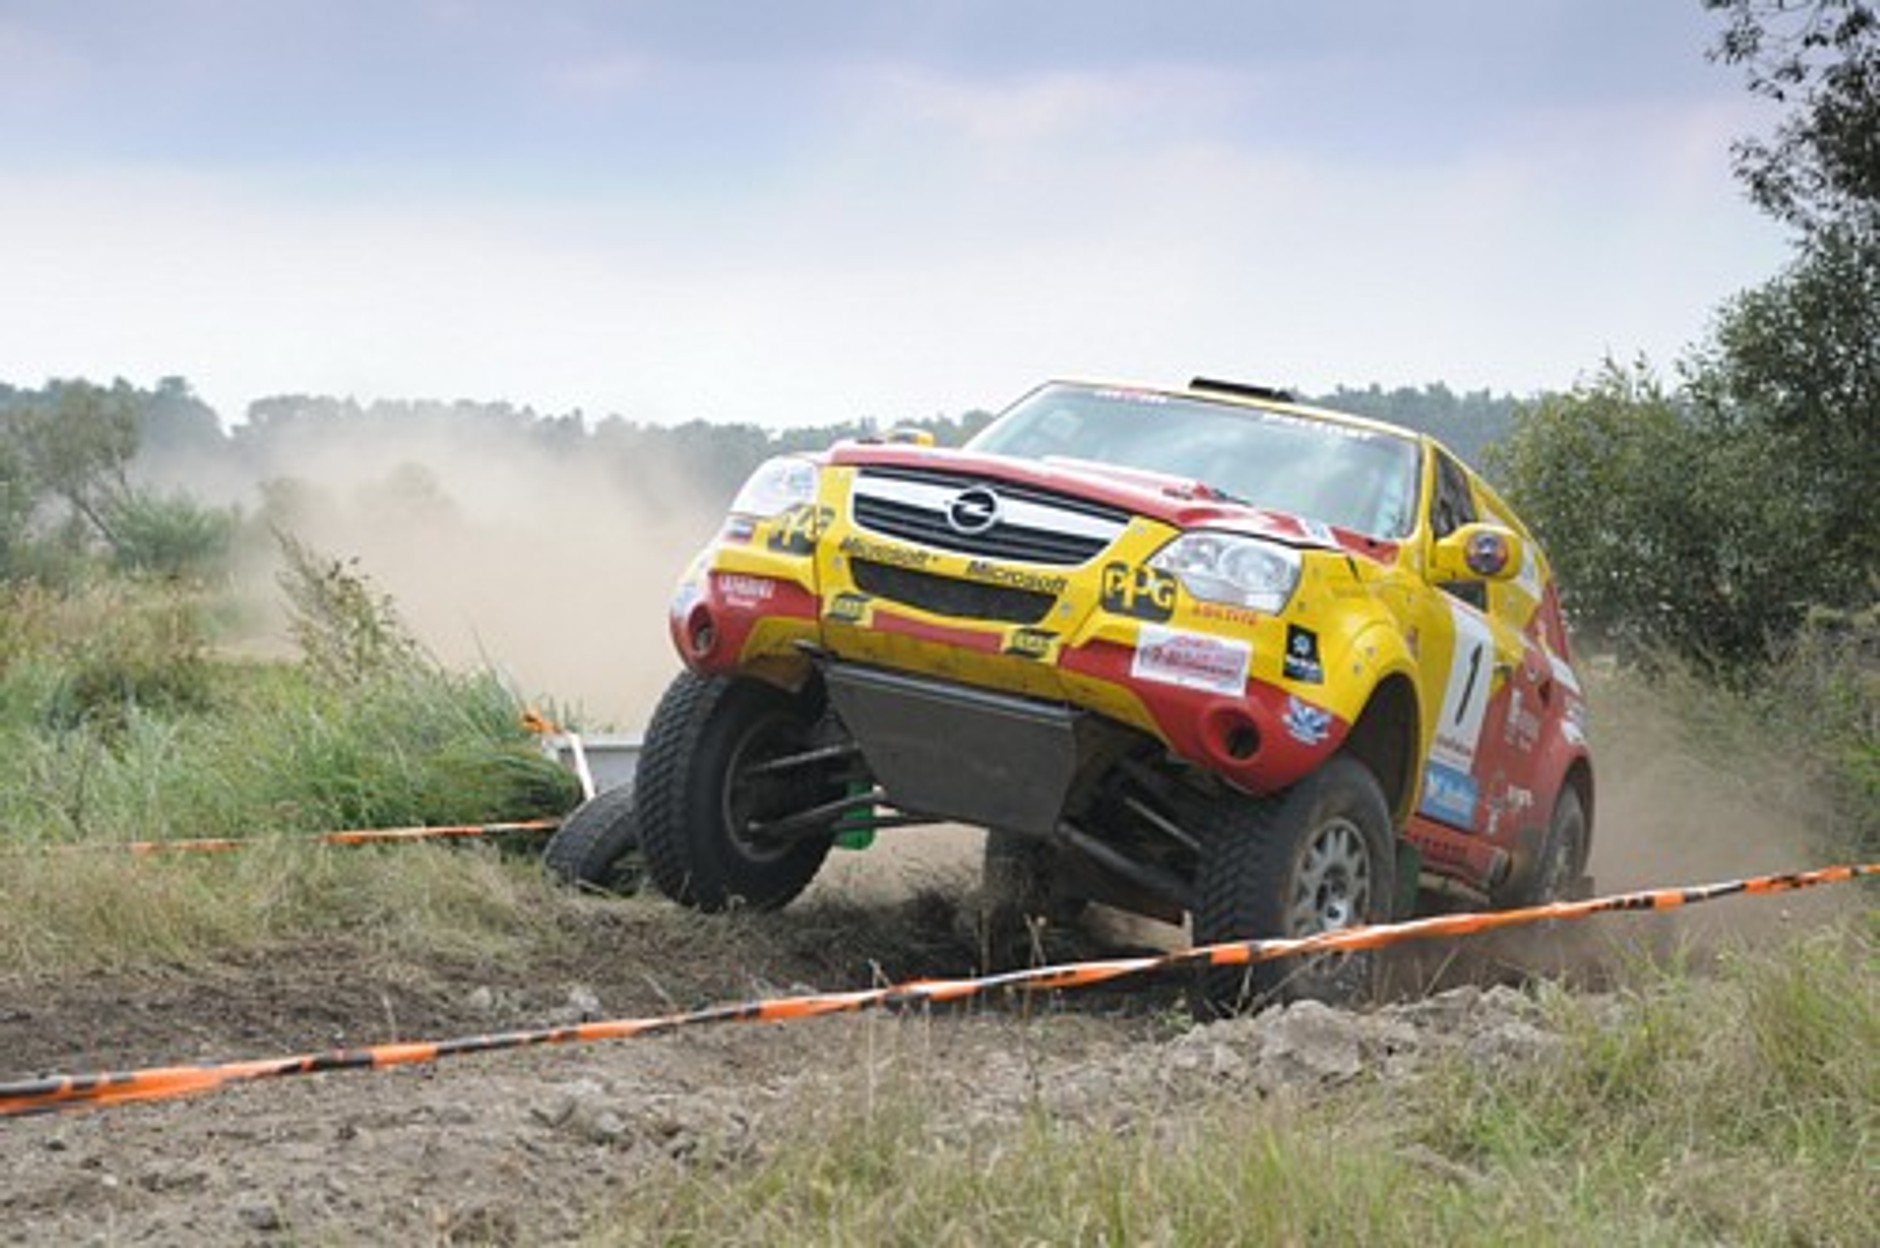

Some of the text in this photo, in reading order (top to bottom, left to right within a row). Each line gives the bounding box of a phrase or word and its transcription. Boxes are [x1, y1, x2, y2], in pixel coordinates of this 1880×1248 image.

[838, 537, 929, 565] Microsoft
[967, 560, 1068, 592] Microsoft
[1103, 567, 1174, 610] PPG
[1454, 643, 1482, 727] 1
